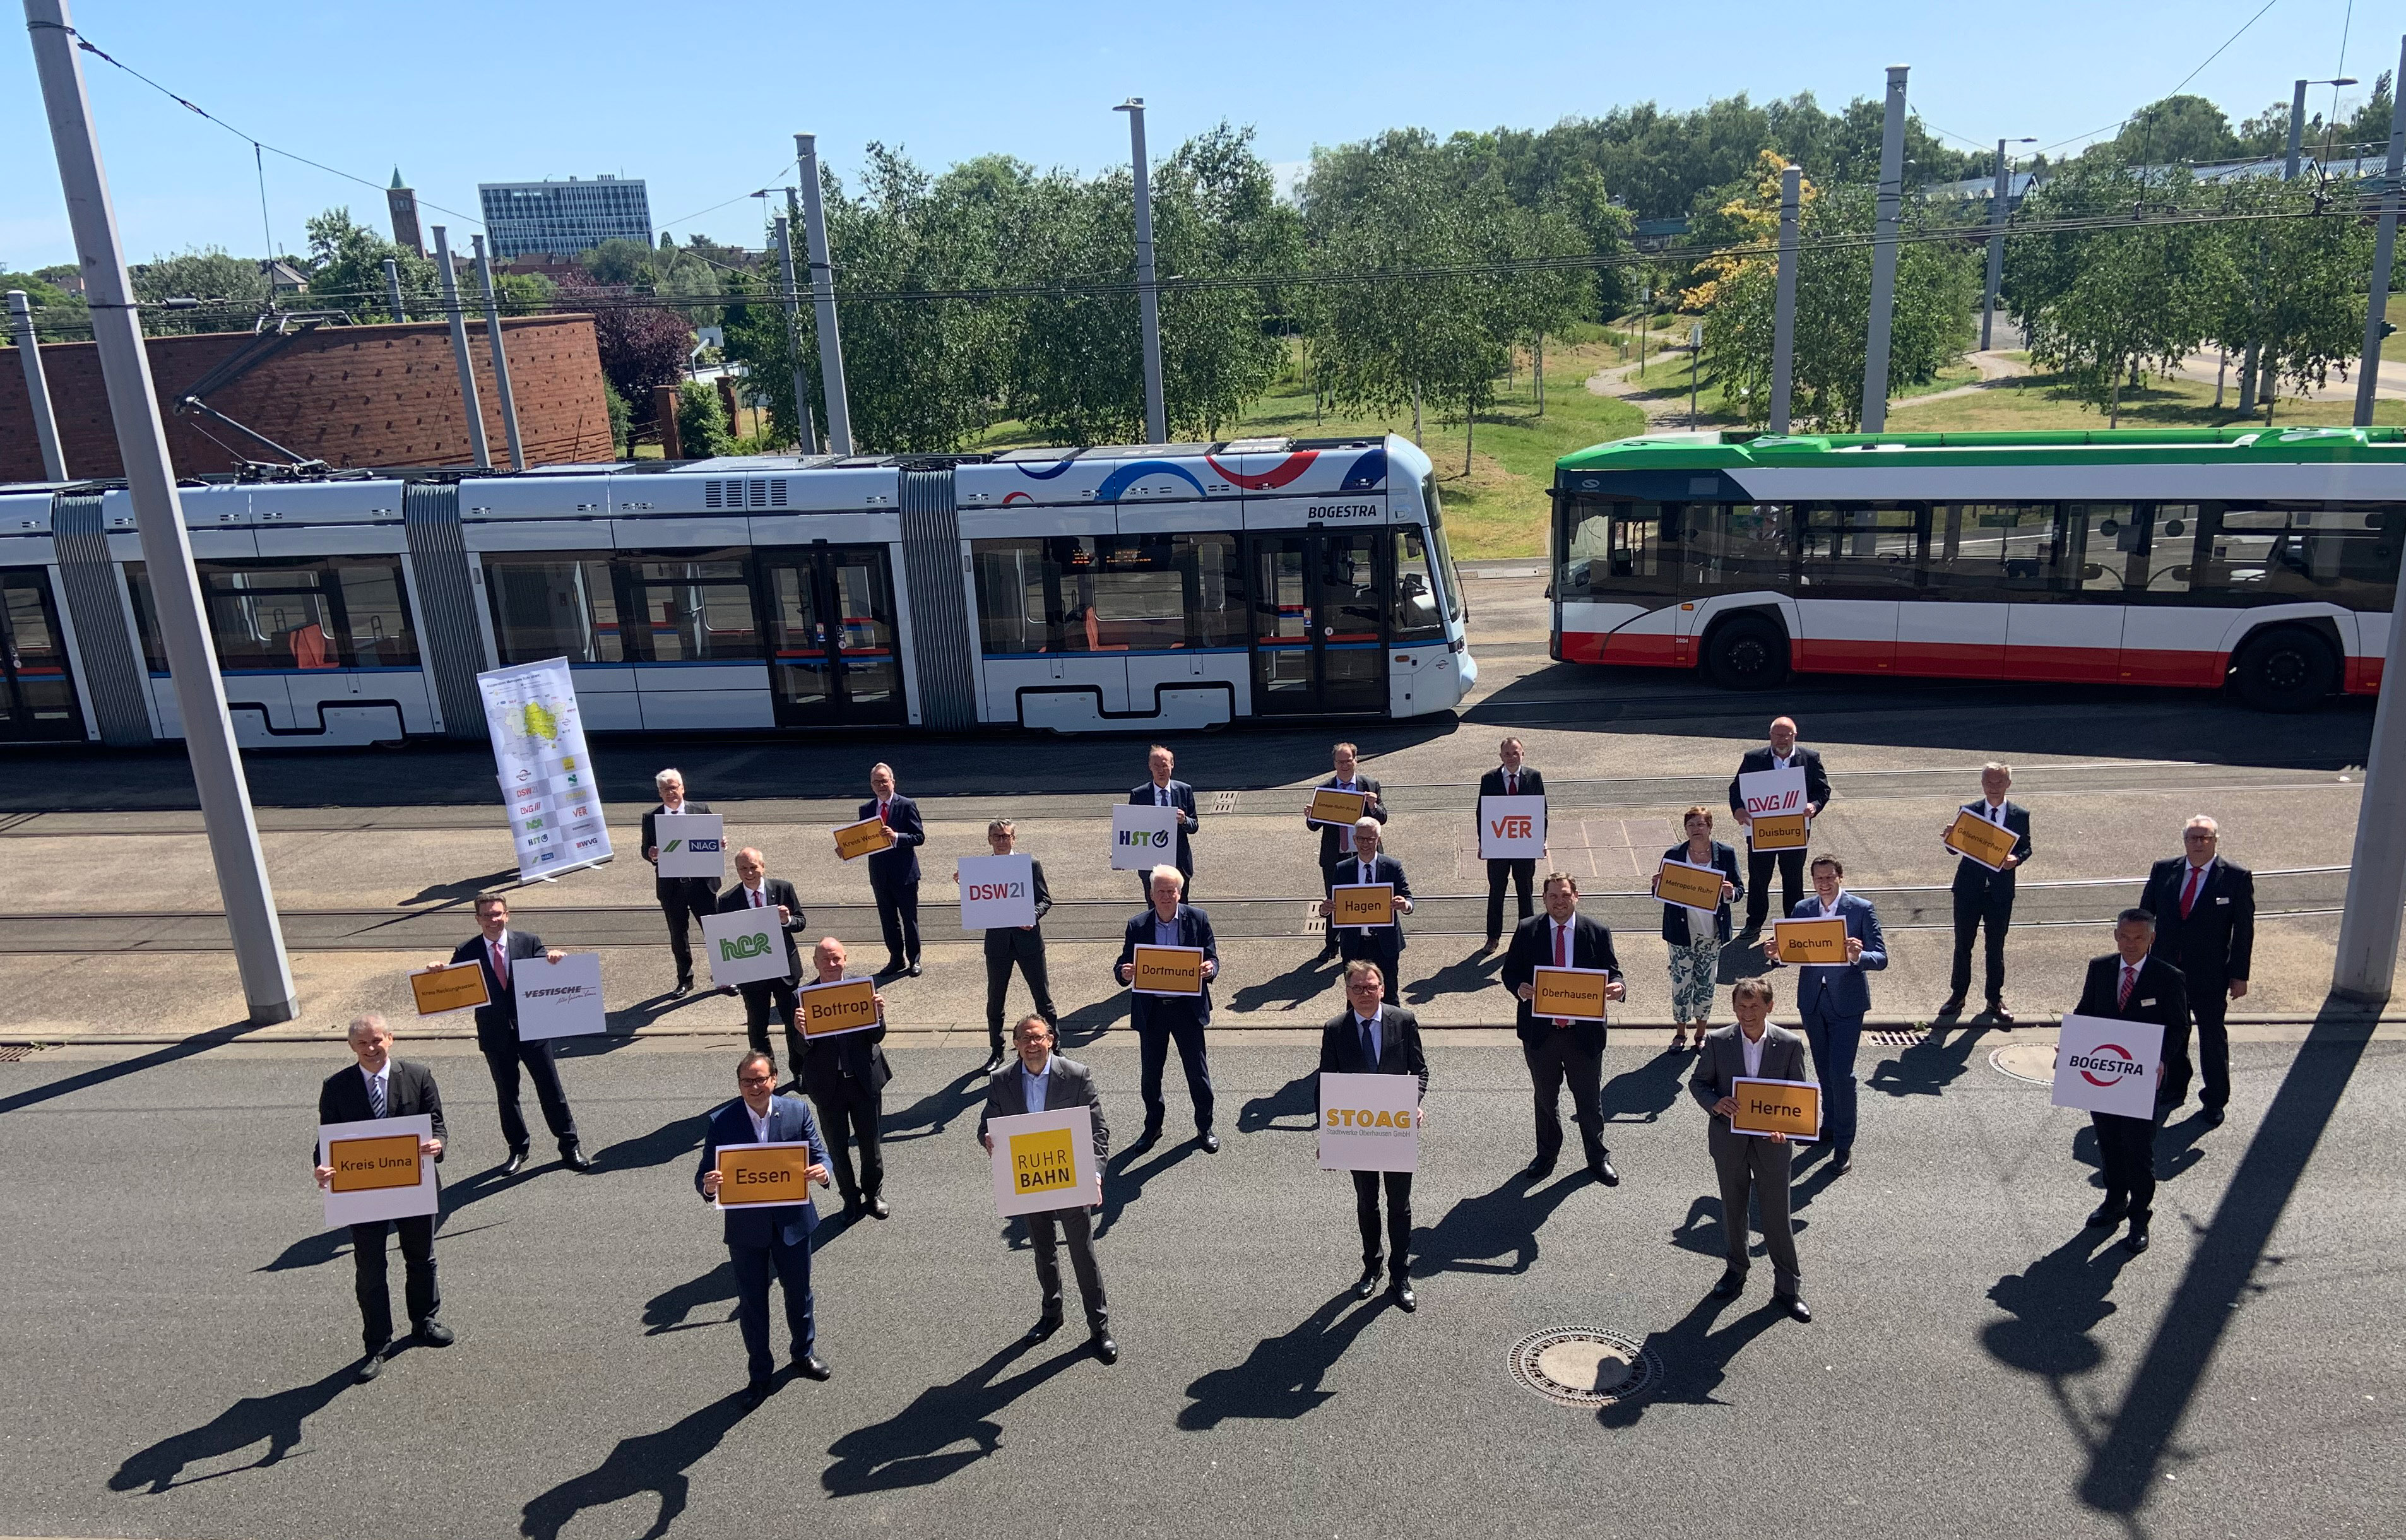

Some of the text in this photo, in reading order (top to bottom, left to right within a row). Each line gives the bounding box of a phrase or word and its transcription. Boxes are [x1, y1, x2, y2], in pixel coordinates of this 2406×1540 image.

[1308, 504, 1377, 518] BOGESTRA
[520, 805, 534, 814] DVG
[1748, 795, 1780, 813] DVG
[572, 806, 588, 817] VER
[1491, 815, 1532, 839] VER
[1758, 828, 1801, 837] Duisburg
[528, 836, 540, 846] HST
[581, 838, 598, 847] WVG
[843, 833, 880, 848] Kreis Wese
[1119, 830, 1151, 846] HST
[1957, 827, 2003, 853] Gelsenkirchen
[690, 841, 717, 850] NIAG
[1666, 879, 1713, 894] Metropole Ruhr
[1345, 901, 1381, 913] Hagen
[1789, 939, 1832, 948] Bochum
[1142, 964, 1195, 977] Dortmund
[524, 986, 581, 998] VESTISCHE
[1542, 988, 1598, 1000] Oberhausen
[811, 1000, 868, 1019] Bottrop
[2069, 1055, 2143, 1075] BOGESTRA
[1751, 1099, 1801, 1117] Herne
[1327, 1108, 1411, 1128] STOAG
[341, 1157, 412, 1171] Kreis Unna
[1018, 1149, 1067, 1170] RUHR
[736, 1168, 790, 1185] Essen
[1020, 1168, 1070, 1188] BAHN
